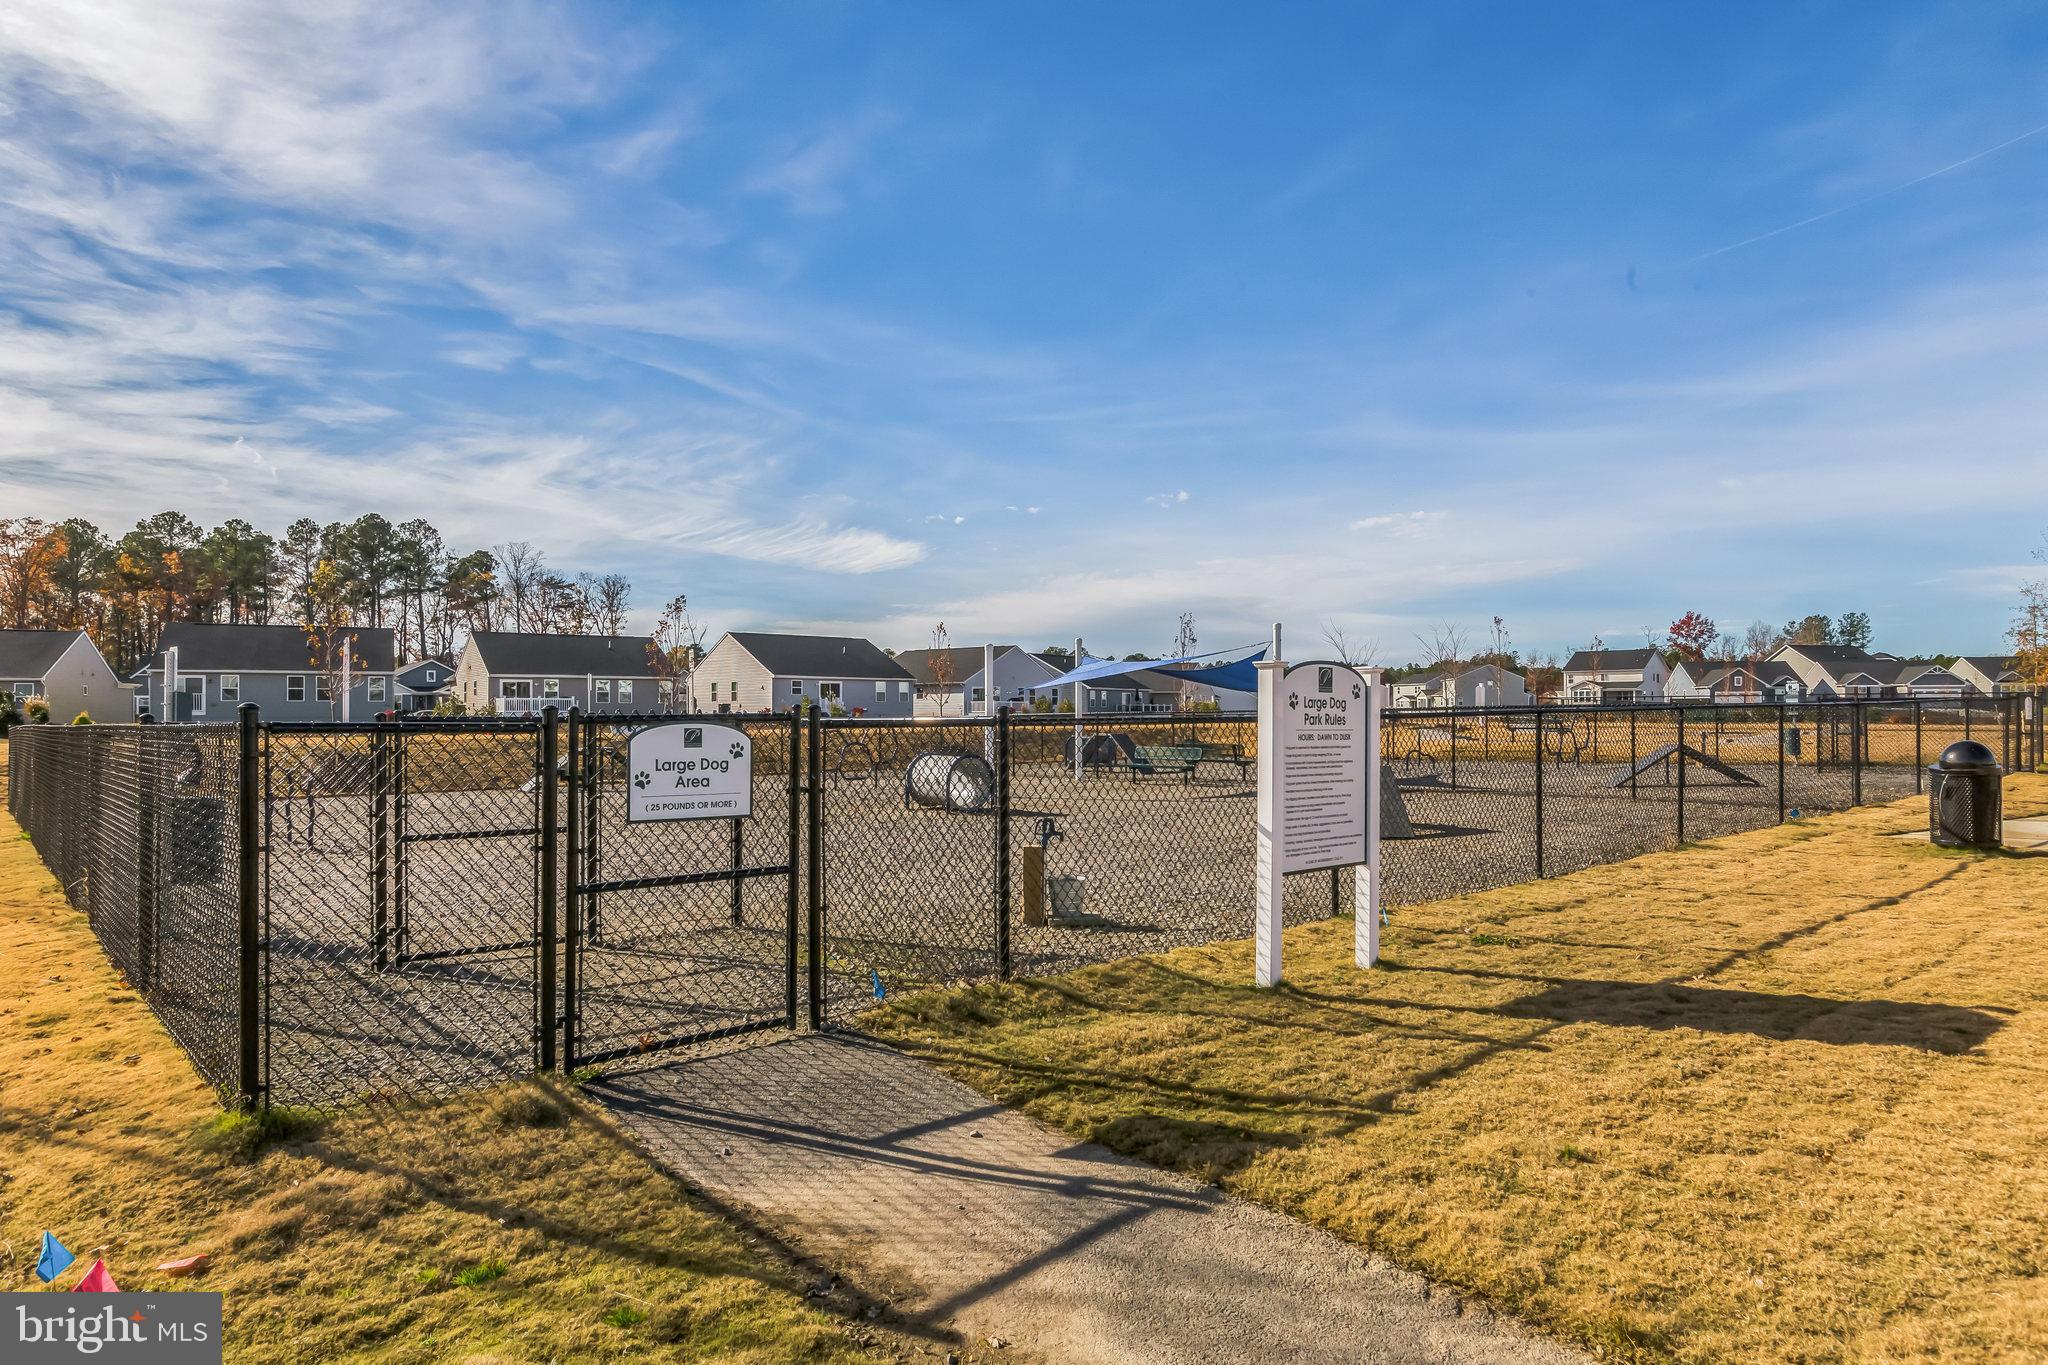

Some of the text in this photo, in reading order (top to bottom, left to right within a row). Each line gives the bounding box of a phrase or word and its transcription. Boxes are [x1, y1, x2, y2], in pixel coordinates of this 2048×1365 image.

[1304, 696, 1347, 712] Large Dog
[1304, 713, 1346, 725] Park Rules
[655, 758, 729, 774] Large Dog
[675, 776, 710, 788] Area
[662, 802, 695, 810] POUNDS
